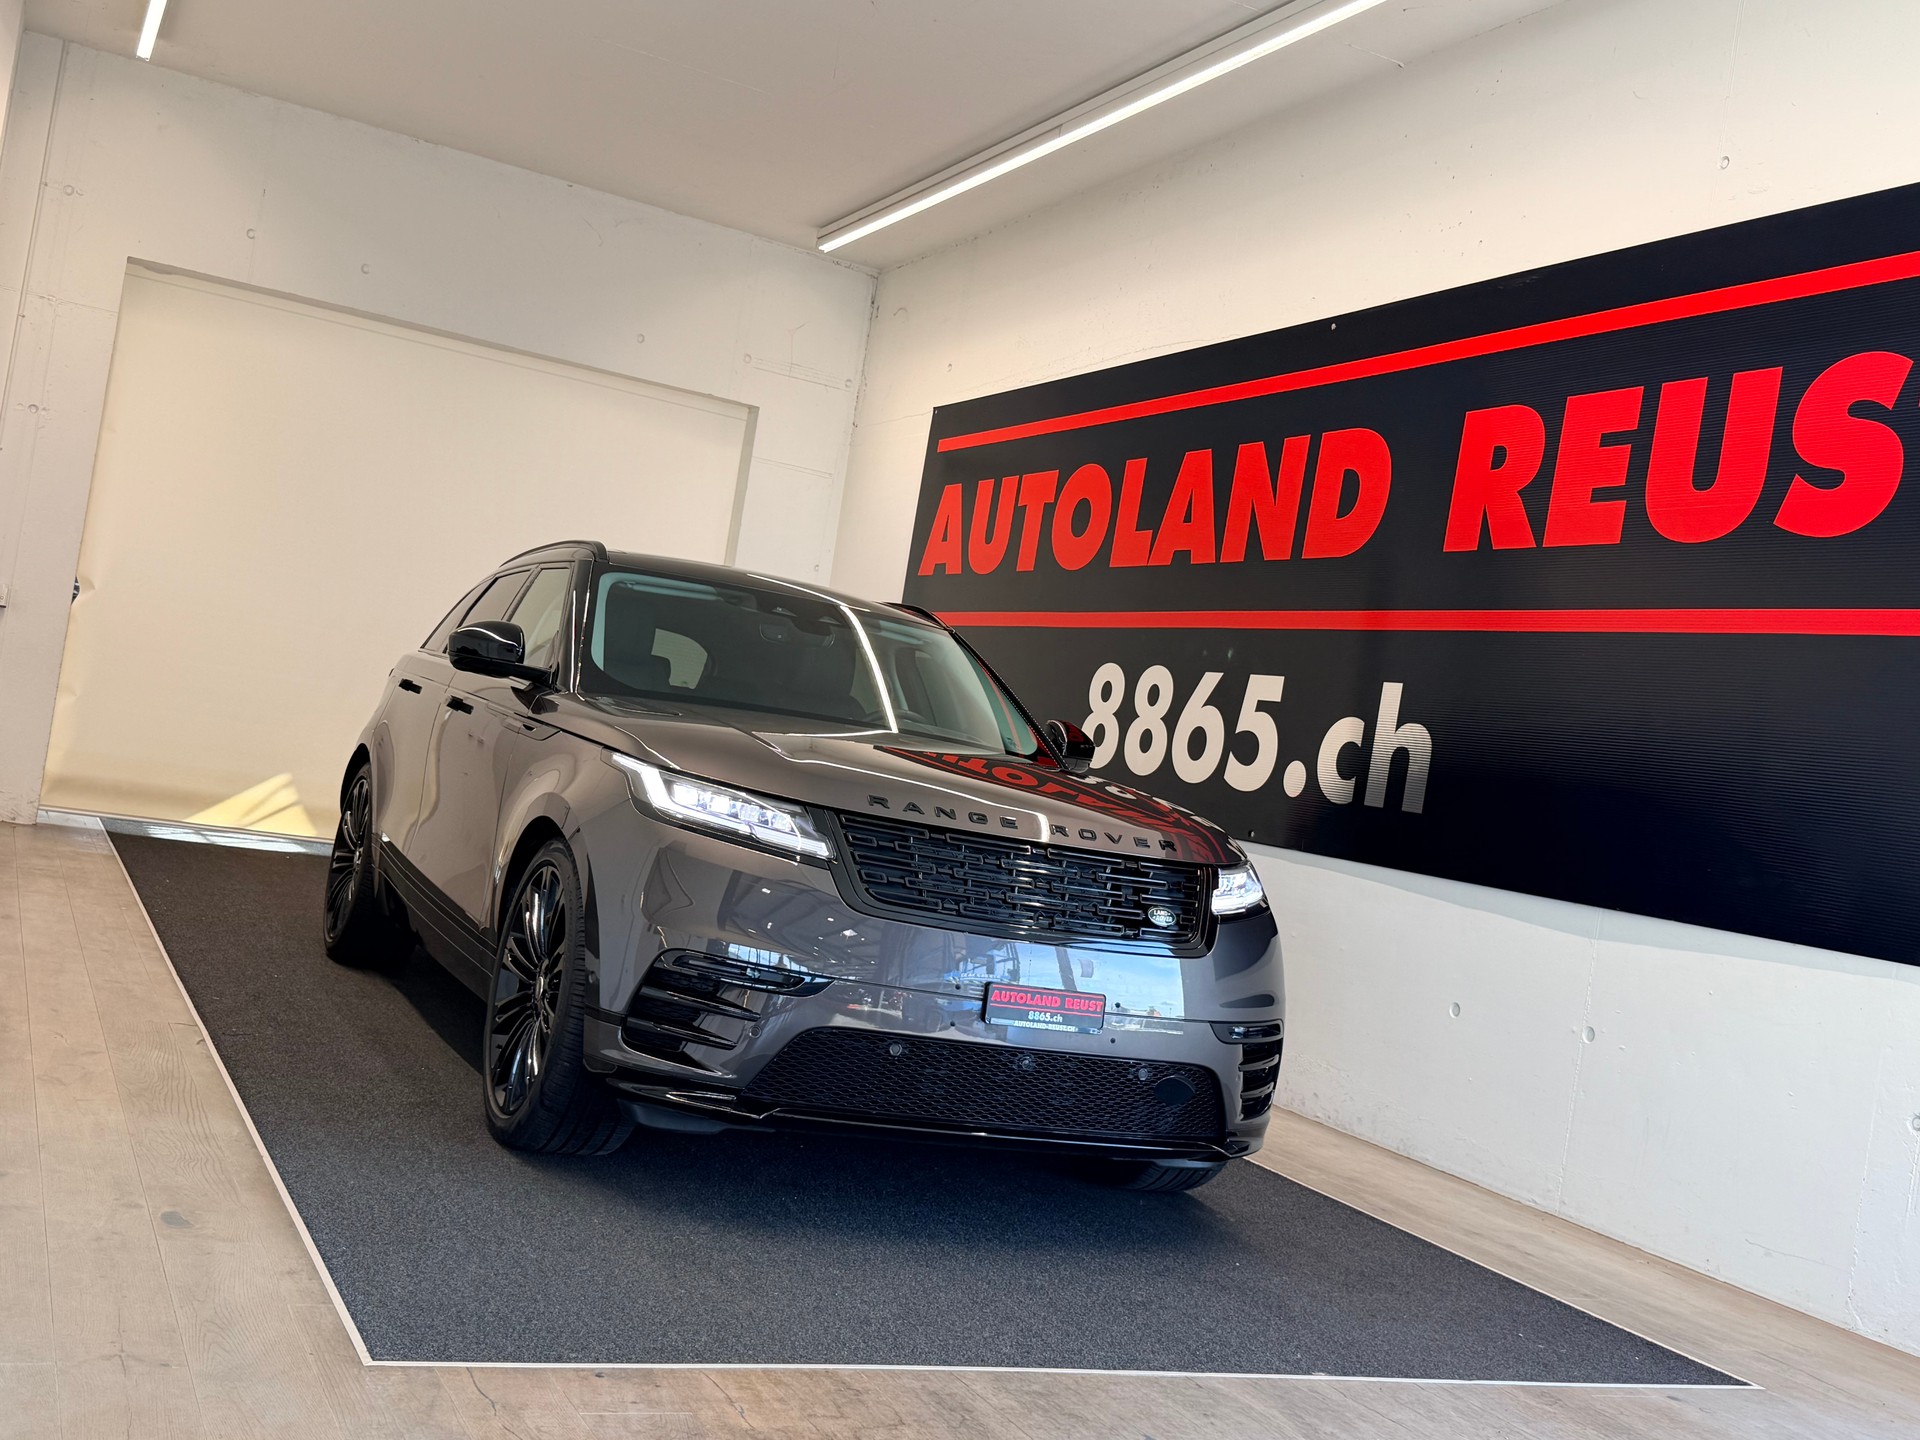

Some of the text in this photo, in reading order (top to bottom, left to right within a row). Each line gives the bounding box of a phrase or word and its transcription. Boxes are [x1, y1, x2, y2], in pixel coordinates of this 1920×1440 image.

[918, 350, 1920, 576] AUTOLAND REUS
[1081, 662, 1433, 814] 8865.ch
[867, 794, 1177, 852] RANGE ROVER
[991, 990, 1103, 1012] AUTOLAND REUST
[1027, 1010, 1063, 1023] 8865.ch
